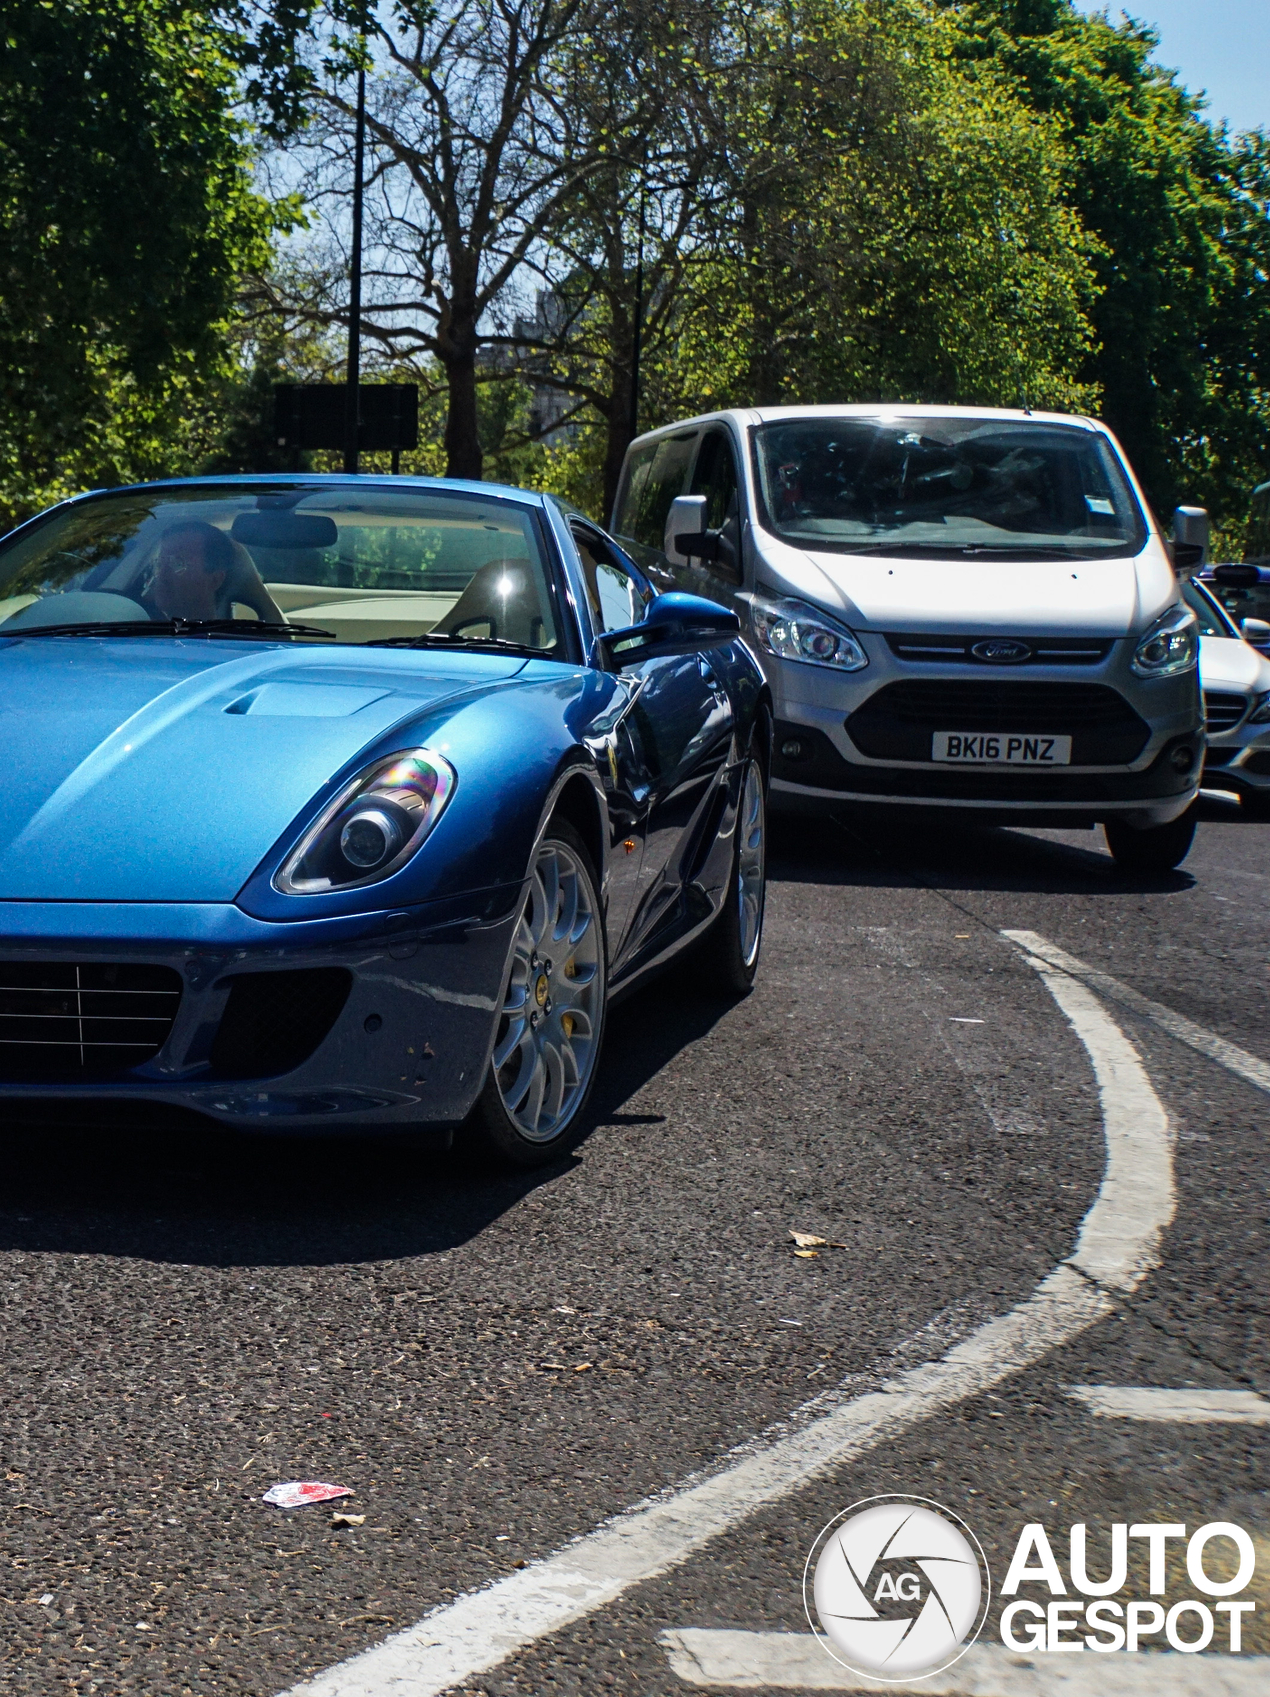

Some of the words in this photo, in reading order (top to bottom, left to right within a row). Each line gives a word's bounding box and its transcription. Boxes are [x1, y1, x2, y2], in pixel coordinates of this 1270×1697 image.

[986, 641, 1019, 656] Ford
[946, 736, 1000, 759] BK16
[1006, 738, 1055, 760] PNZ
